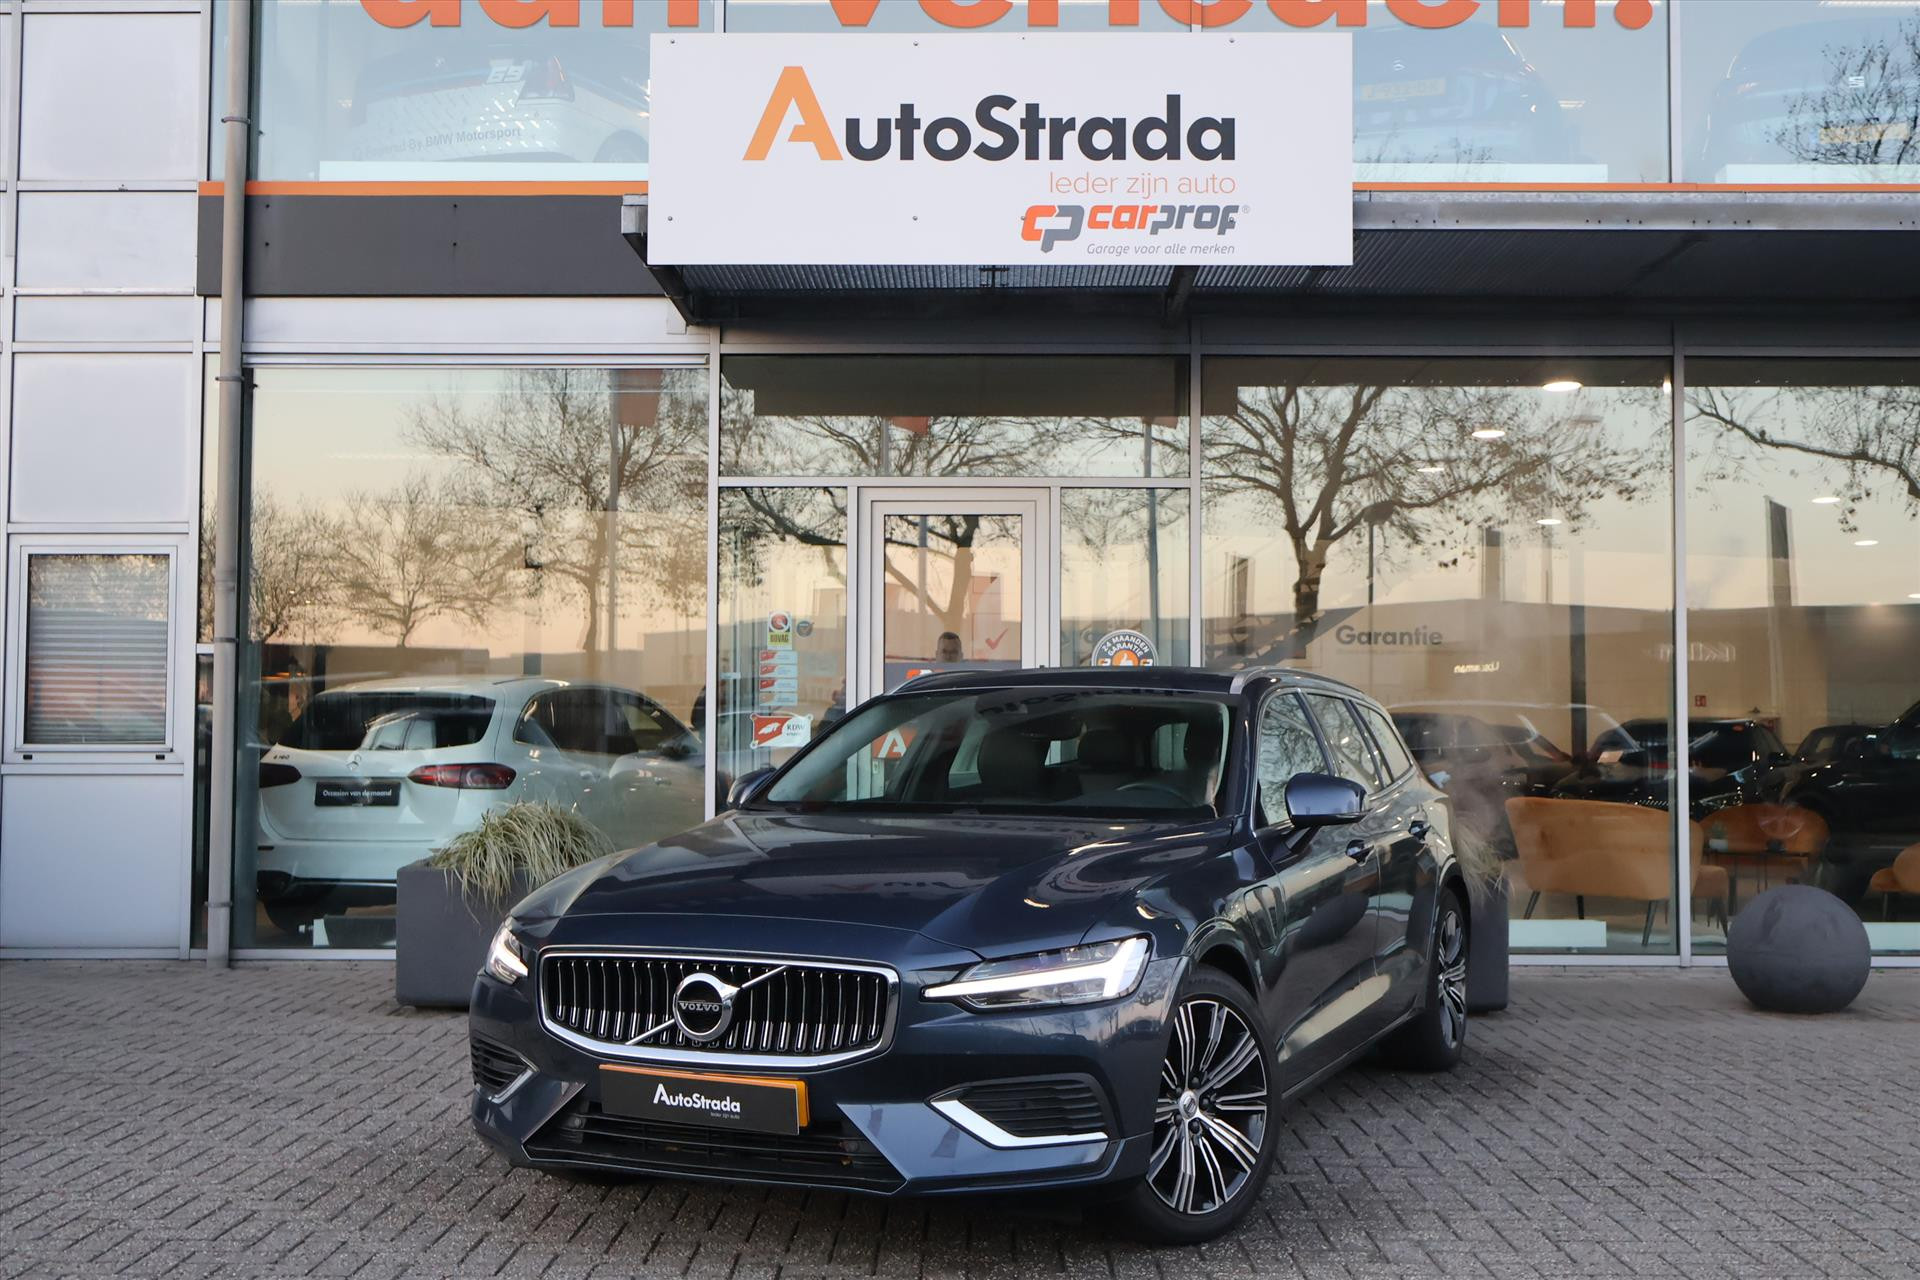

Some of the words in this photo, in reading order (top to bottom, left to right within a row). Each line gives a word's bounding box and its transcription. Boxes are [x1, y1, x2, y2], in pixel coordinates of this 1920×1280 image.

[742, 66, 1237, 162] AutoStrada
[425, 133, 453, 147] BMW
[456, 127, 521, 143] Motorsport
[1049, 172, 1118, 195] Ieder
[1126, 172, 1169, 199] zijn
[1177, 173, 1236, 195] auto
[1087, 204, 1240, 236] carprof
[1087, 243, 1130, 257] Garage
[1134, 245, 1161, 255] voor
[1164, 243, 1189, 255] alle
[1190, 243, 1236, 255] merken
[1101, 640, 1113, 653] 24
[1112, 633, 1150, 653] MAANDEN
[1335, 624, 1443, 646] Garantie
[1107, 641, 1144, 658] GARANTIE
[679, 1001, 720, 1013] VOLVO
[653, 1083, 741, 1114] AutoStrada
